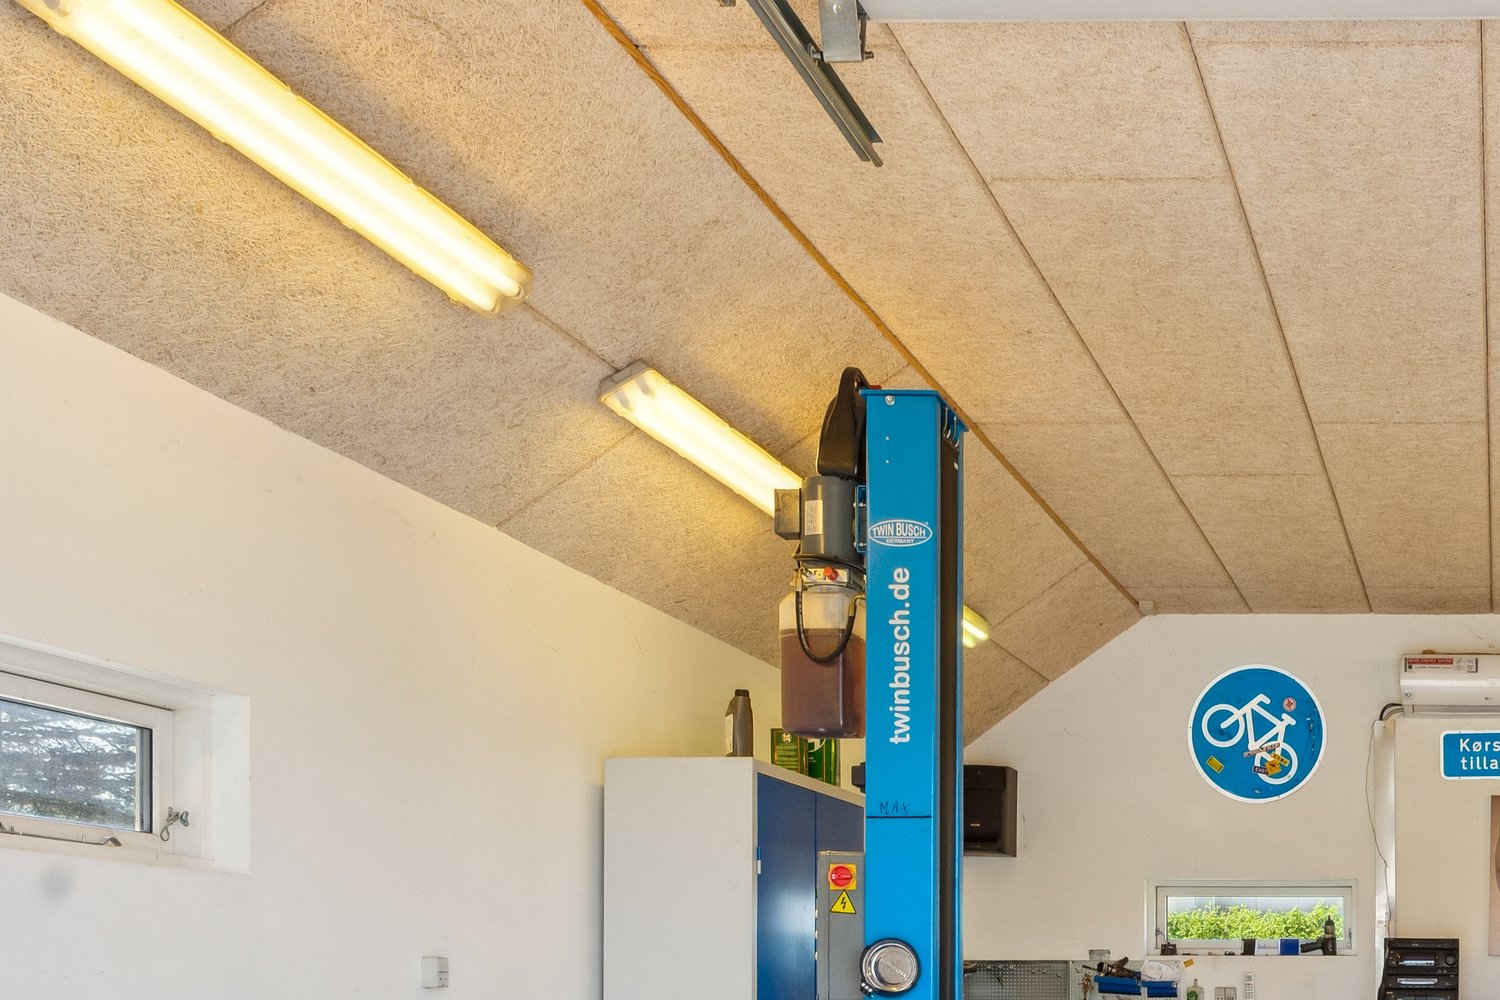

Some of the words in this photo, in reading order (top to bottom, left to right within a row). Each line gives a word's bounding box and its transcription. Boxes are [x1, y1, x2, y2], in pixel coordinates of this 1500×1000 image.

[871, 523, 895, 536] TWIN
[895, 522, 926, 537] BUSCH
[888, 566, 911, 745] twinbusch.de
[880, 800, 911, 816] MAX
